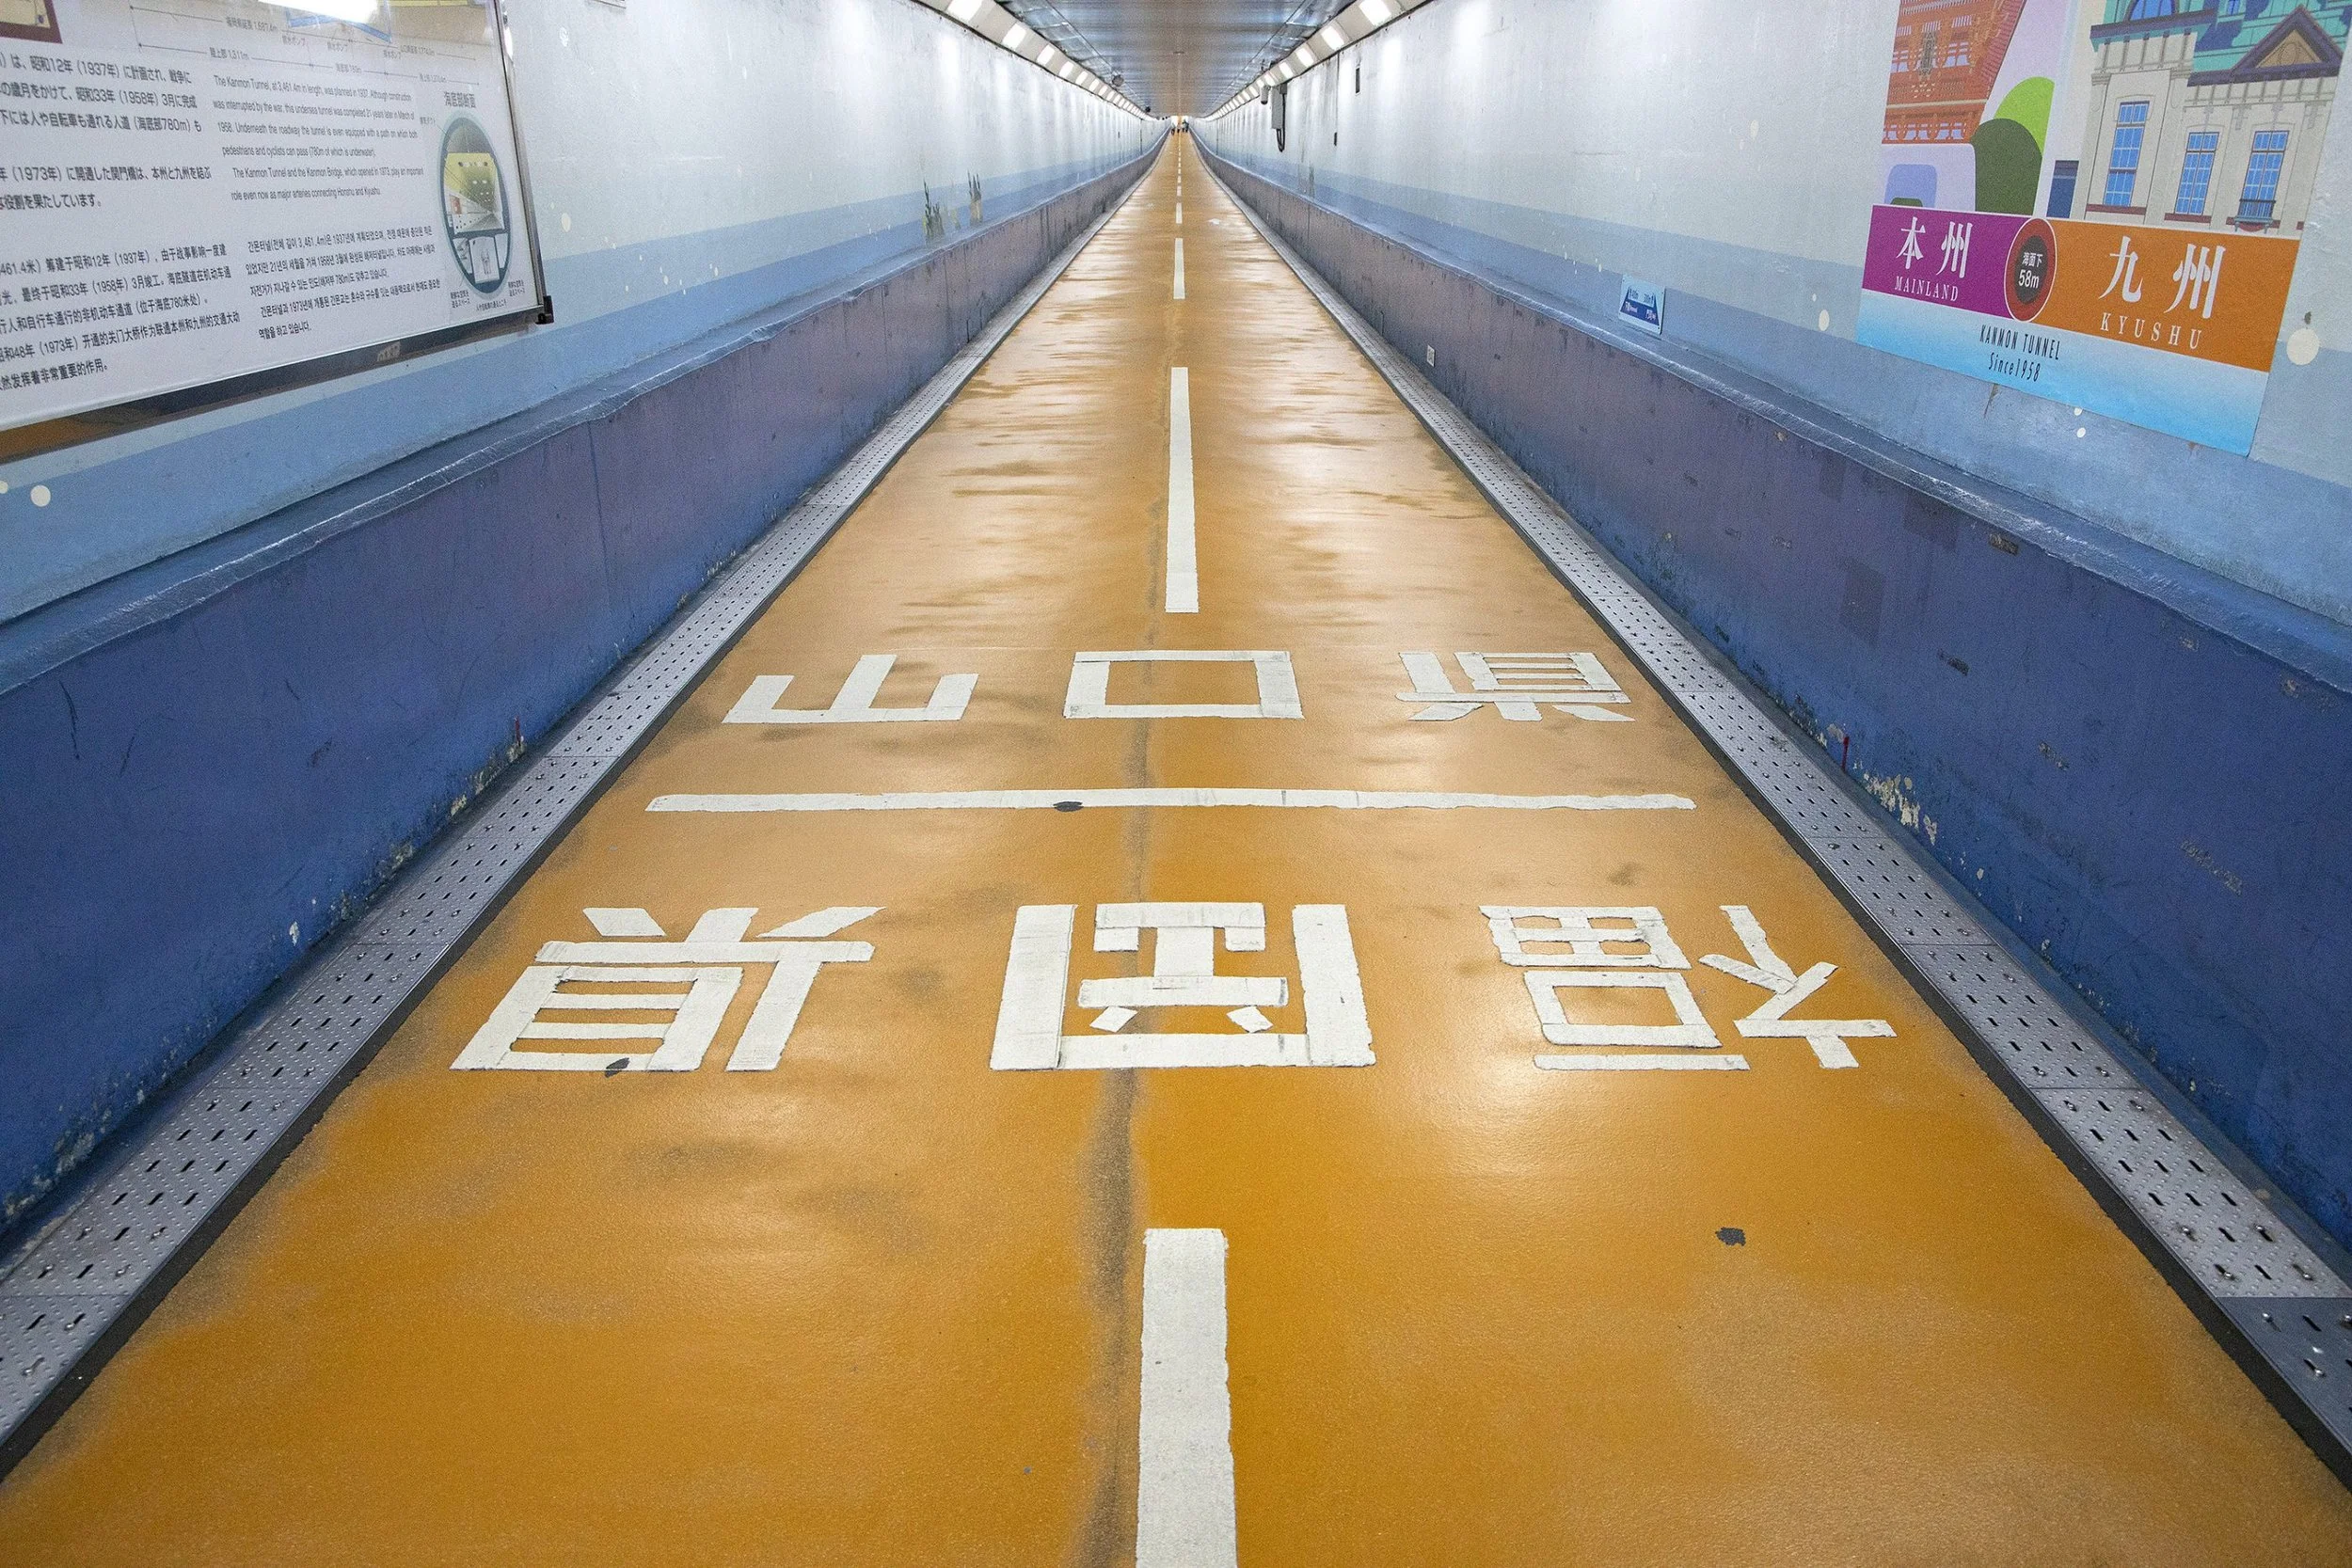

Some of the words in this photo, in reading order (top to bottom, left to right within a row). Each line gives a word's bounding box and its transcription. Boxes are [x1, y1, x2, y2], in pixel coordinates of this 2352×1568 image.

[1896, 215, 1974, 278] 本州
[2022, 251, 2043, 267] 海面下
[1894, 275, 1960, 303] MAINLAND
[2018, 269, 2040, 289] 58m
[2098, 235, 2226, 319] 九州
[1979, 324, 2019, 350] KANMON
[2023, 333, 2061, 361] TUNNEL
[2099, 311, 2203, 350] KYUSHU
[722, 650, 1633, 725] 山口県
